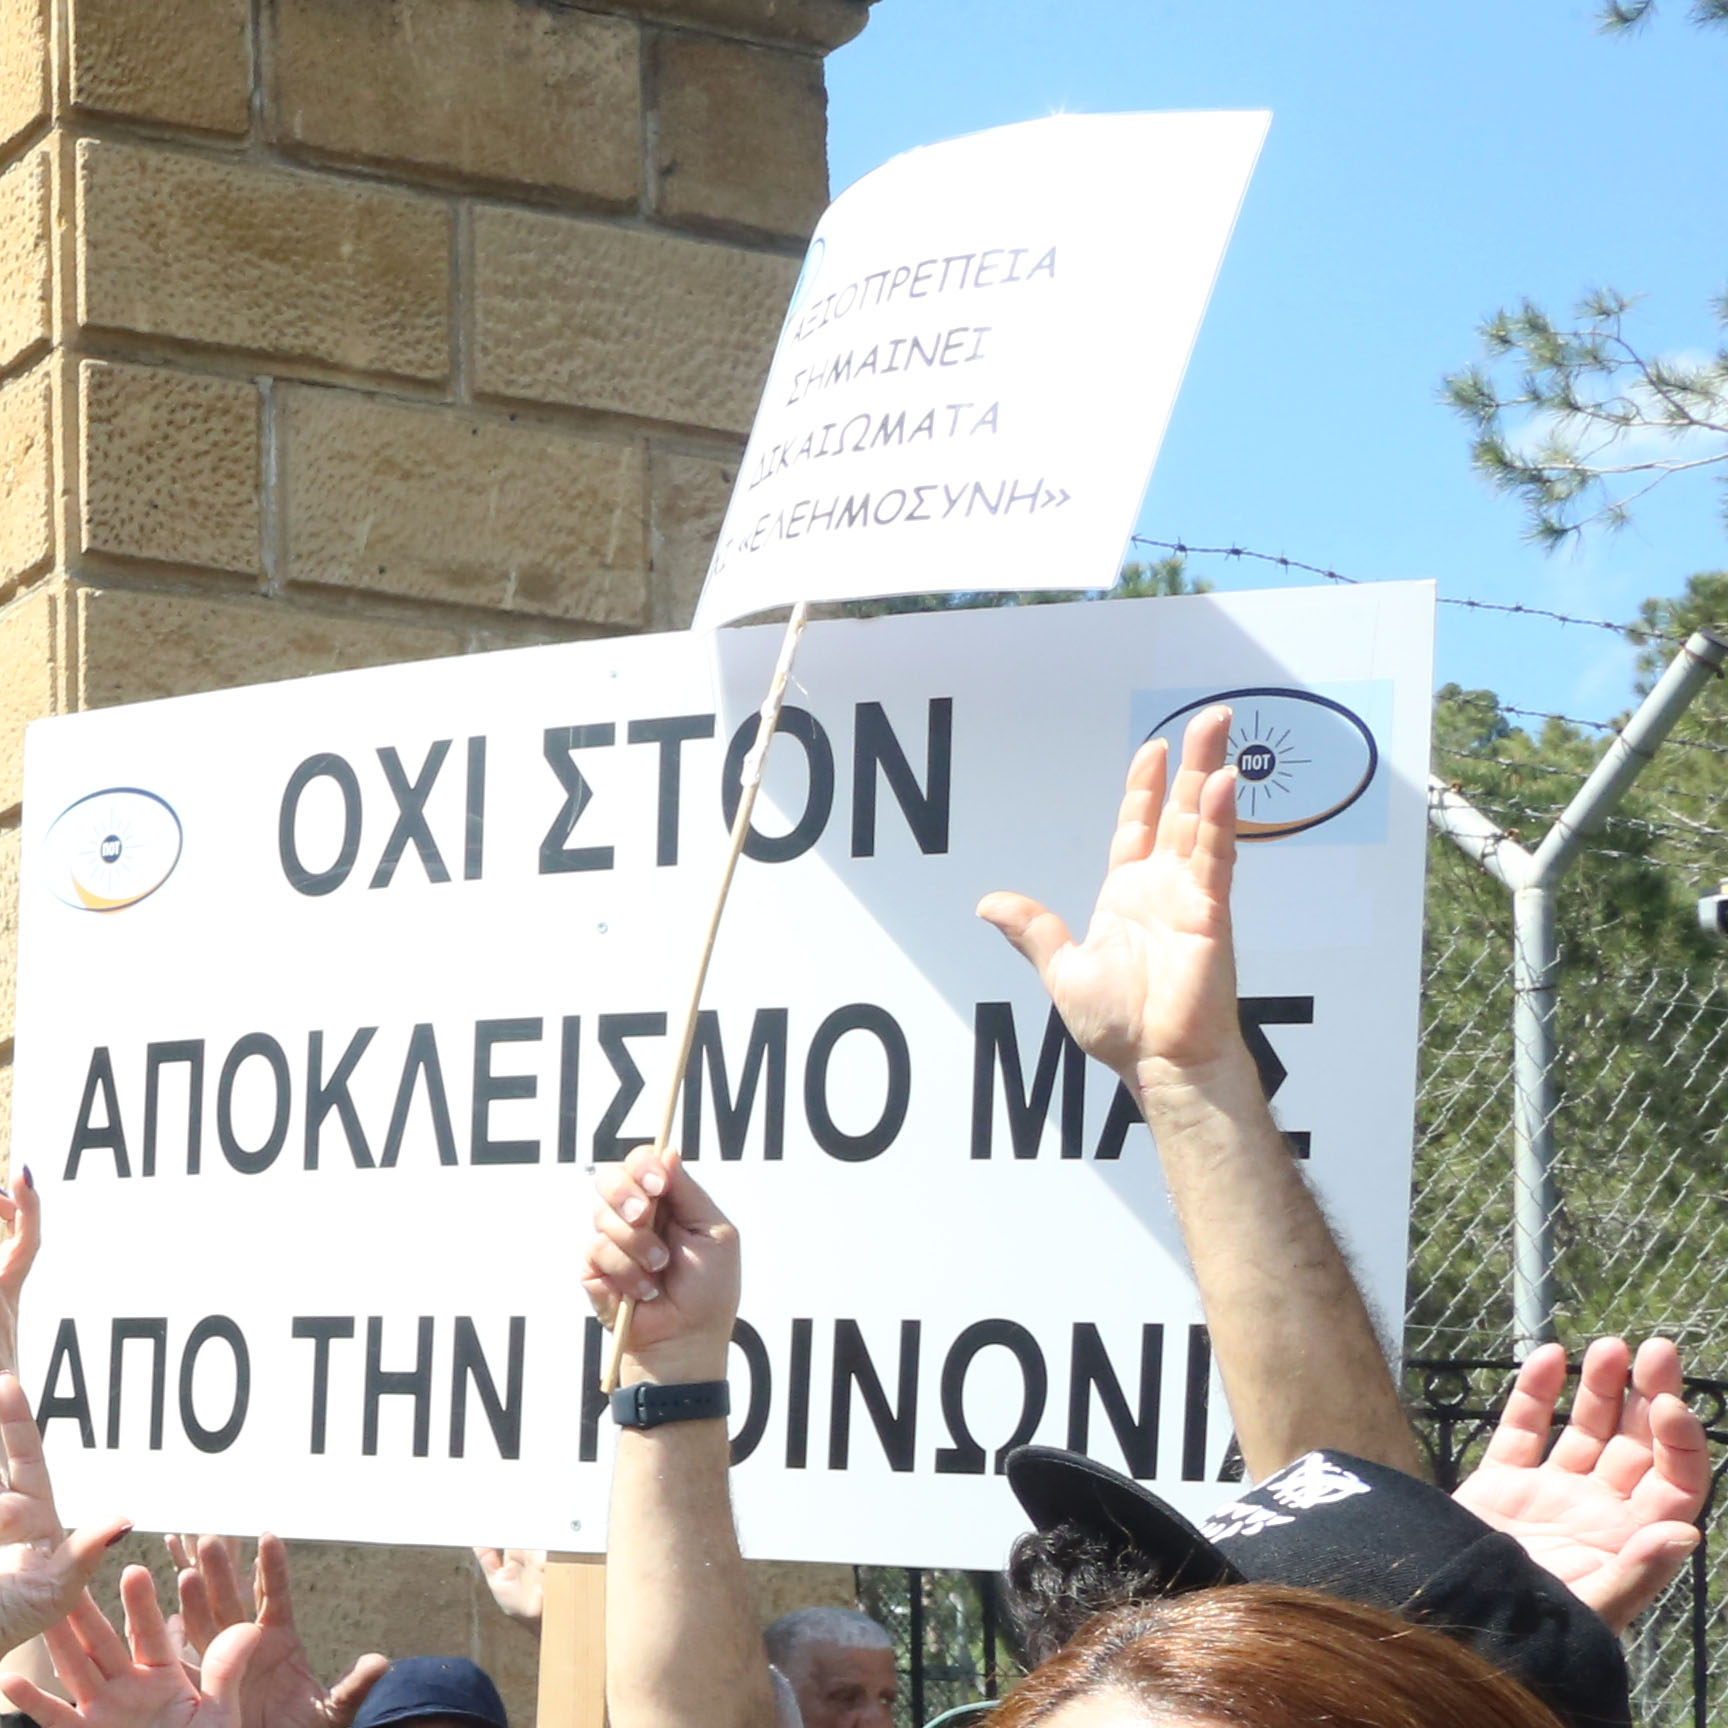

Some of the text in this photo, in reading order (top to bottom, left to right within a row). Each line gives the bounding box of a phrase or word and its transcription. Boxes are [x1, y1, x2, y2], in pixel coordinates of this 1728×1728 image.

[786, 327, 993, 407] ΣΗΜΑΙΝΕΙ
[749, 401, 1000, 491] ΔΙΚΑΙΩΜΑΤΑ
[278, 696, 953, 897] ΟΧΙ ΣΤΟΝ
[1242, 754, 1271, 771] ΠΟΤ
[63, 996, 1314, 1180] ΑΠΟΚΛΕΙΣΜΟ ΜΣ
[35, 1313, 249, 1454] ΑΠΟ
[291, 1314, 526, 1462] ΤΗΝ
